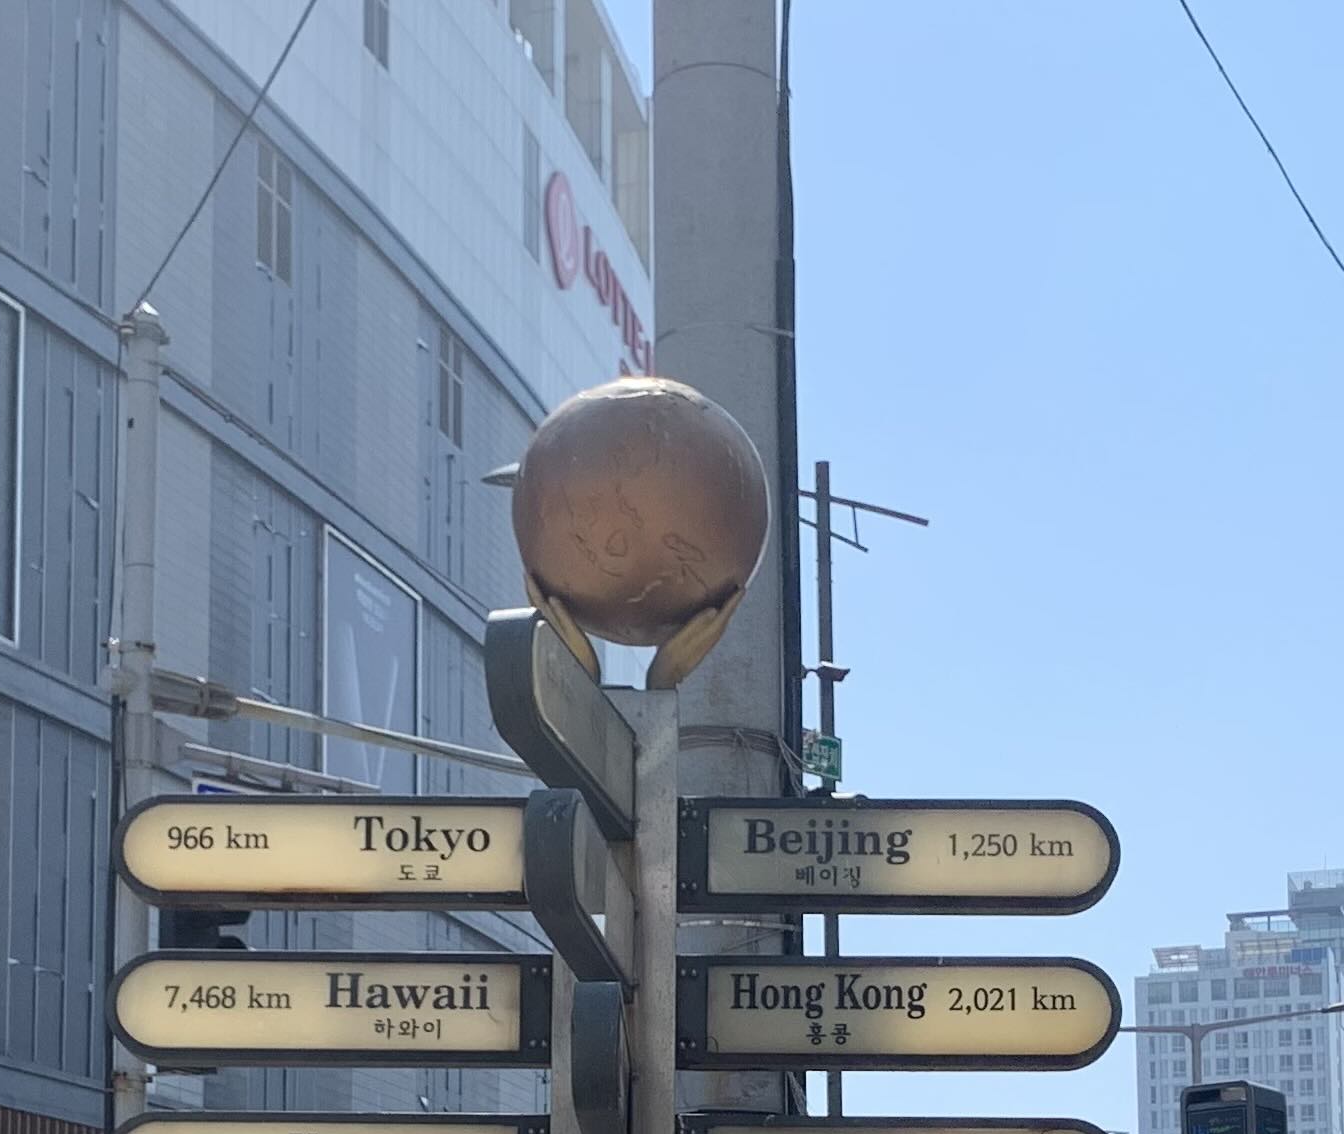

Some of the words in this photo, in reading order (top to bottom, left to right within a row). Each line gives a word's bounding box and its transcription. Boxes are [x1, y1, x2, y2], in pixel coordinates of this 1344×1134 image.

[167, 826, 214, 850] 966
[226, 826, 270, 850] km
[354, 816, 491, 860] Tokyo
[744, 819, 913, 865] Beijing
[949, 833, 1018, 861] 1,250
[1030, 832, 1074, 857] km
[397, 865, 443, 881] 도쿄
[164, 985, 236, 1013] 7,468
[248, 986, 291, 1010] km
[325, 972, 491, 1010] Hawaii
[731, 974, 825, 1019] Hong
[835, 974, 927, 1019] Kong
[949, 988, 1016, 1017] 2,021
[1032, 987, 1077, 1011] km
[375, 1018, 442, 1040] 하와이
[806, 1023, 851, 1046] 홍콩
